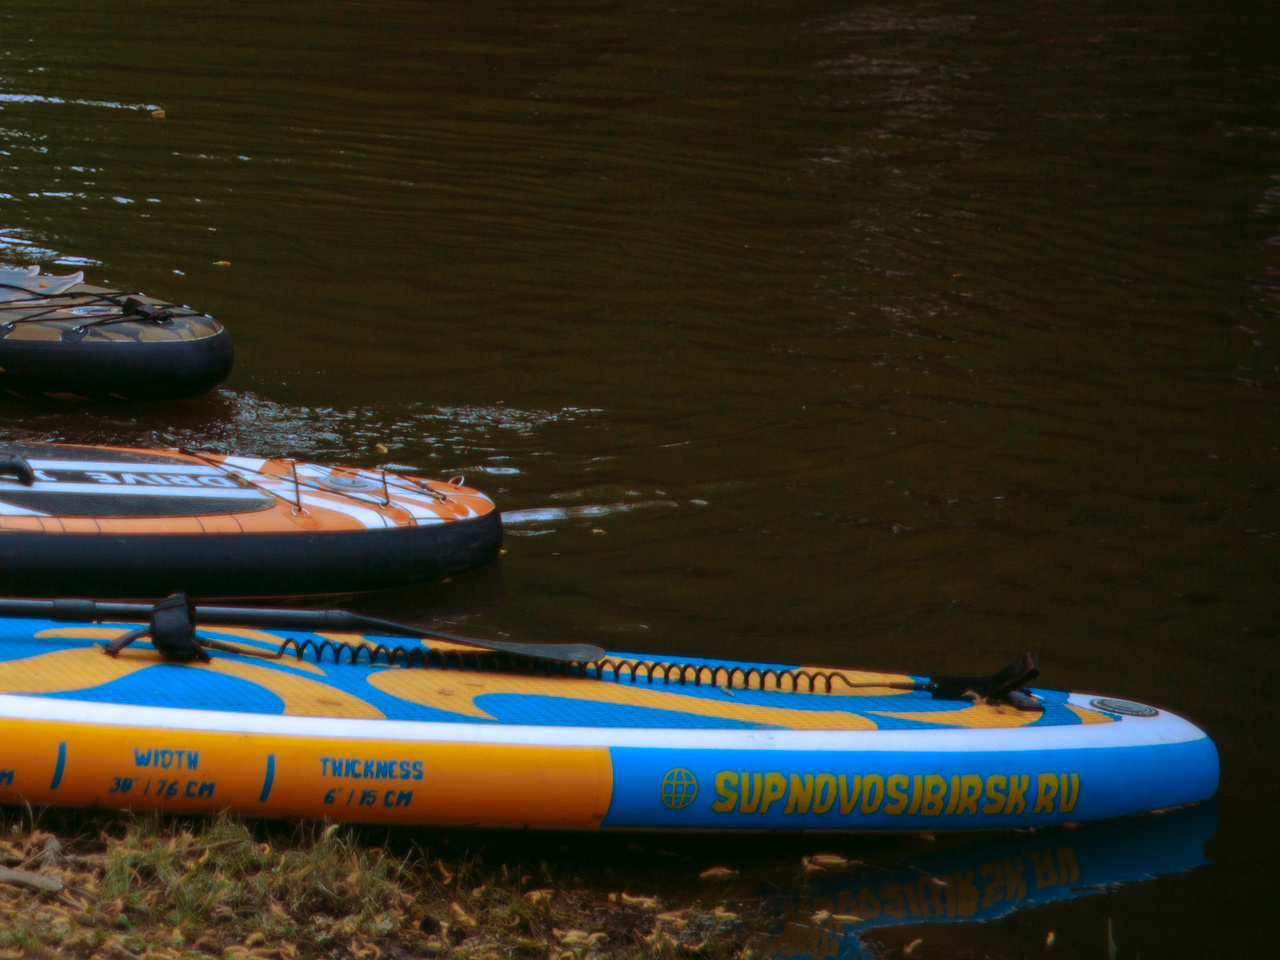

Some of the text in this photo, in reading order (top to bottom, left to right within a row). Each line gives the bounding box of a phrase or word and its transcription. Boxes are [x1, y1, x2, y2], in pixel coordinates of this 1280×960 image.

[85, 471, 239, 488] DRIVE
[133, 746, 199, 771] WIDTH
[319, 756, 424, 781] THICKNESS
[184, 780, 215, 798] CM
[359, 789, 378, 806] 15
[383, 790, 413, 808] CM
[711, 769, 1081, 817] SUPNOVOSIBIRSK.RU
